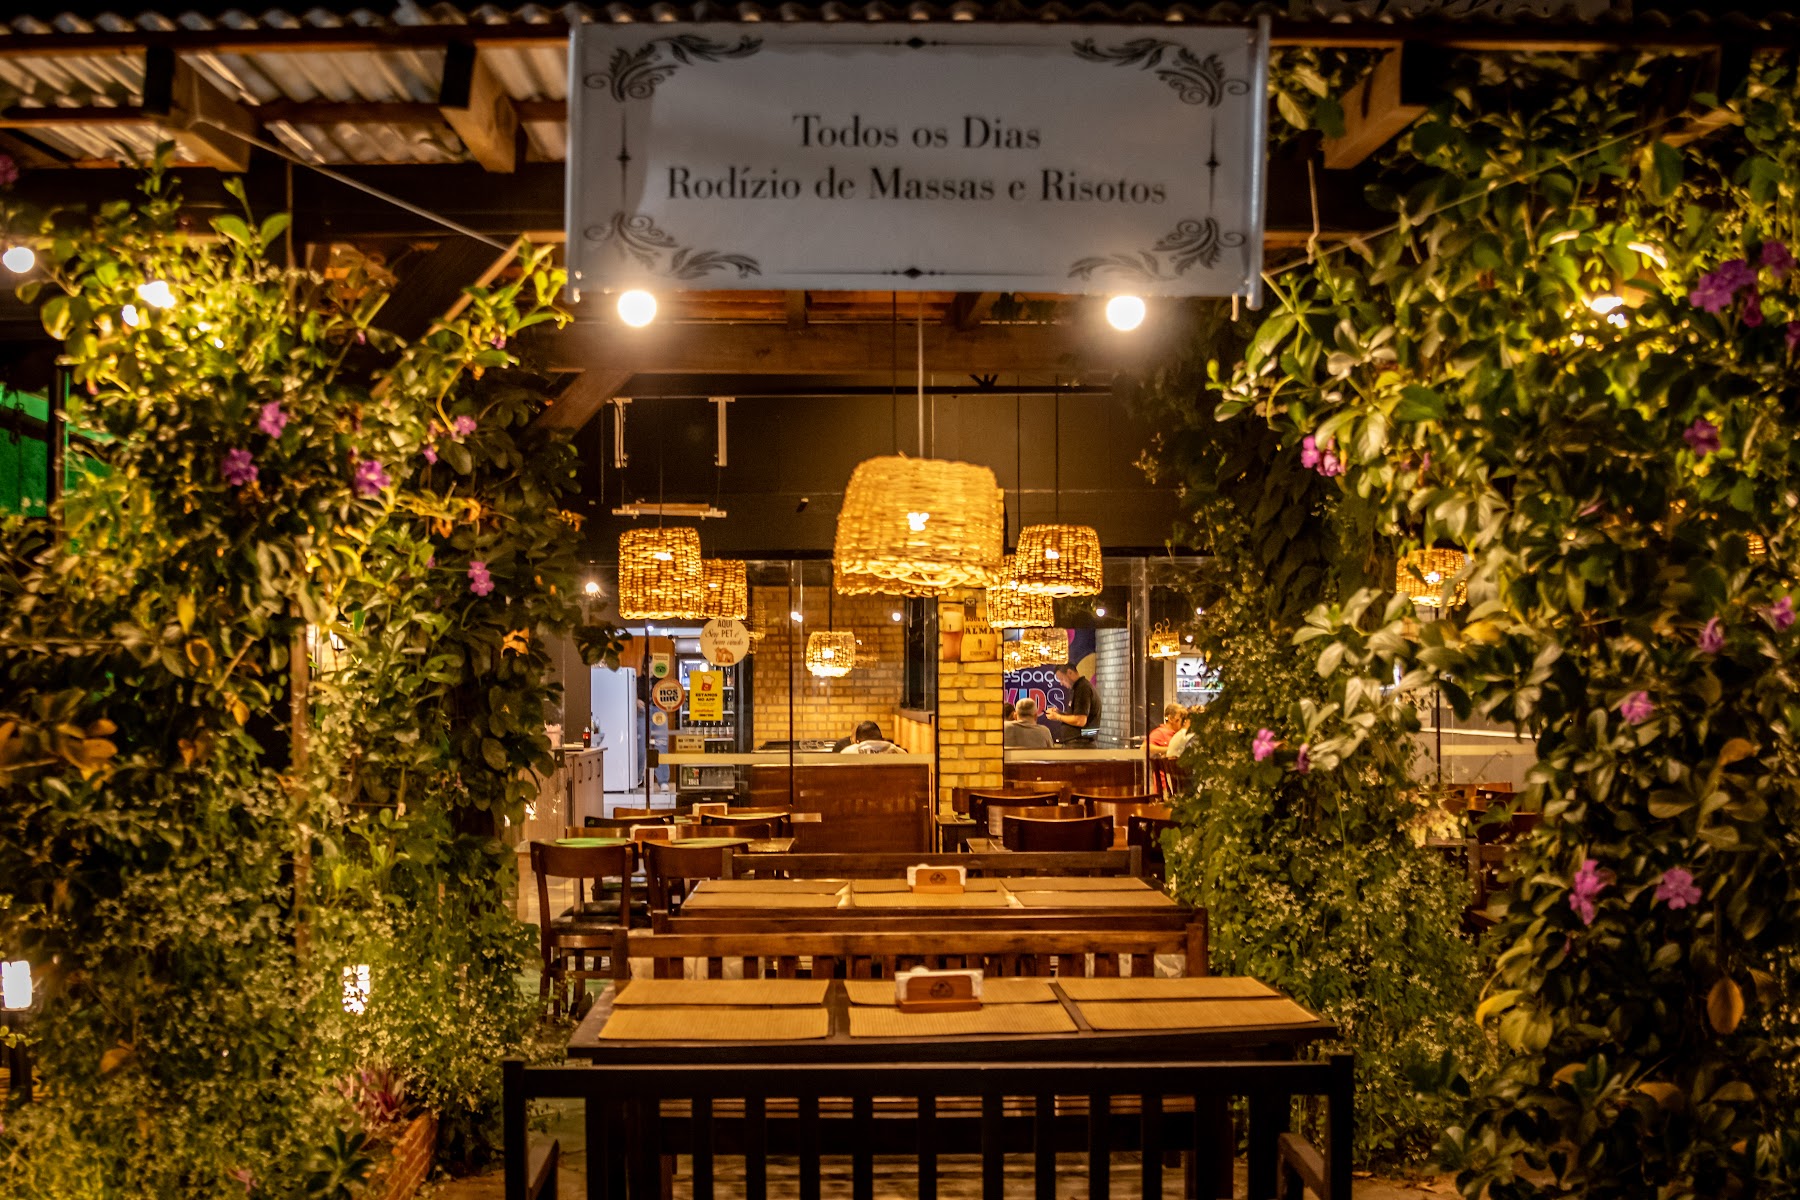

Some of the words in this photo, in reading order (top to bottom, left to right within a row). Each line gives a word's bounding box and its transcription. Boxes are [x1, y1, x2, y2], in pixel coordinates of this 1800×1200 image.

[793, 114, 898, 149] Todos
[912, 124, 948, 149] os
[962, 115, 1041, 150] Dias
[667, 166, 801, 201] Rodízio
[815, 166, 854, 201] de
[869, 168, 996, 201] Massas
[1009, 178, 1026, 202] e
[1040, 170, 1167, 204] Risotos
[717, 620, 733, 628] AQUI
[721, 629, 733, 637] PET
[965, 627, 995, 635] ALMA
